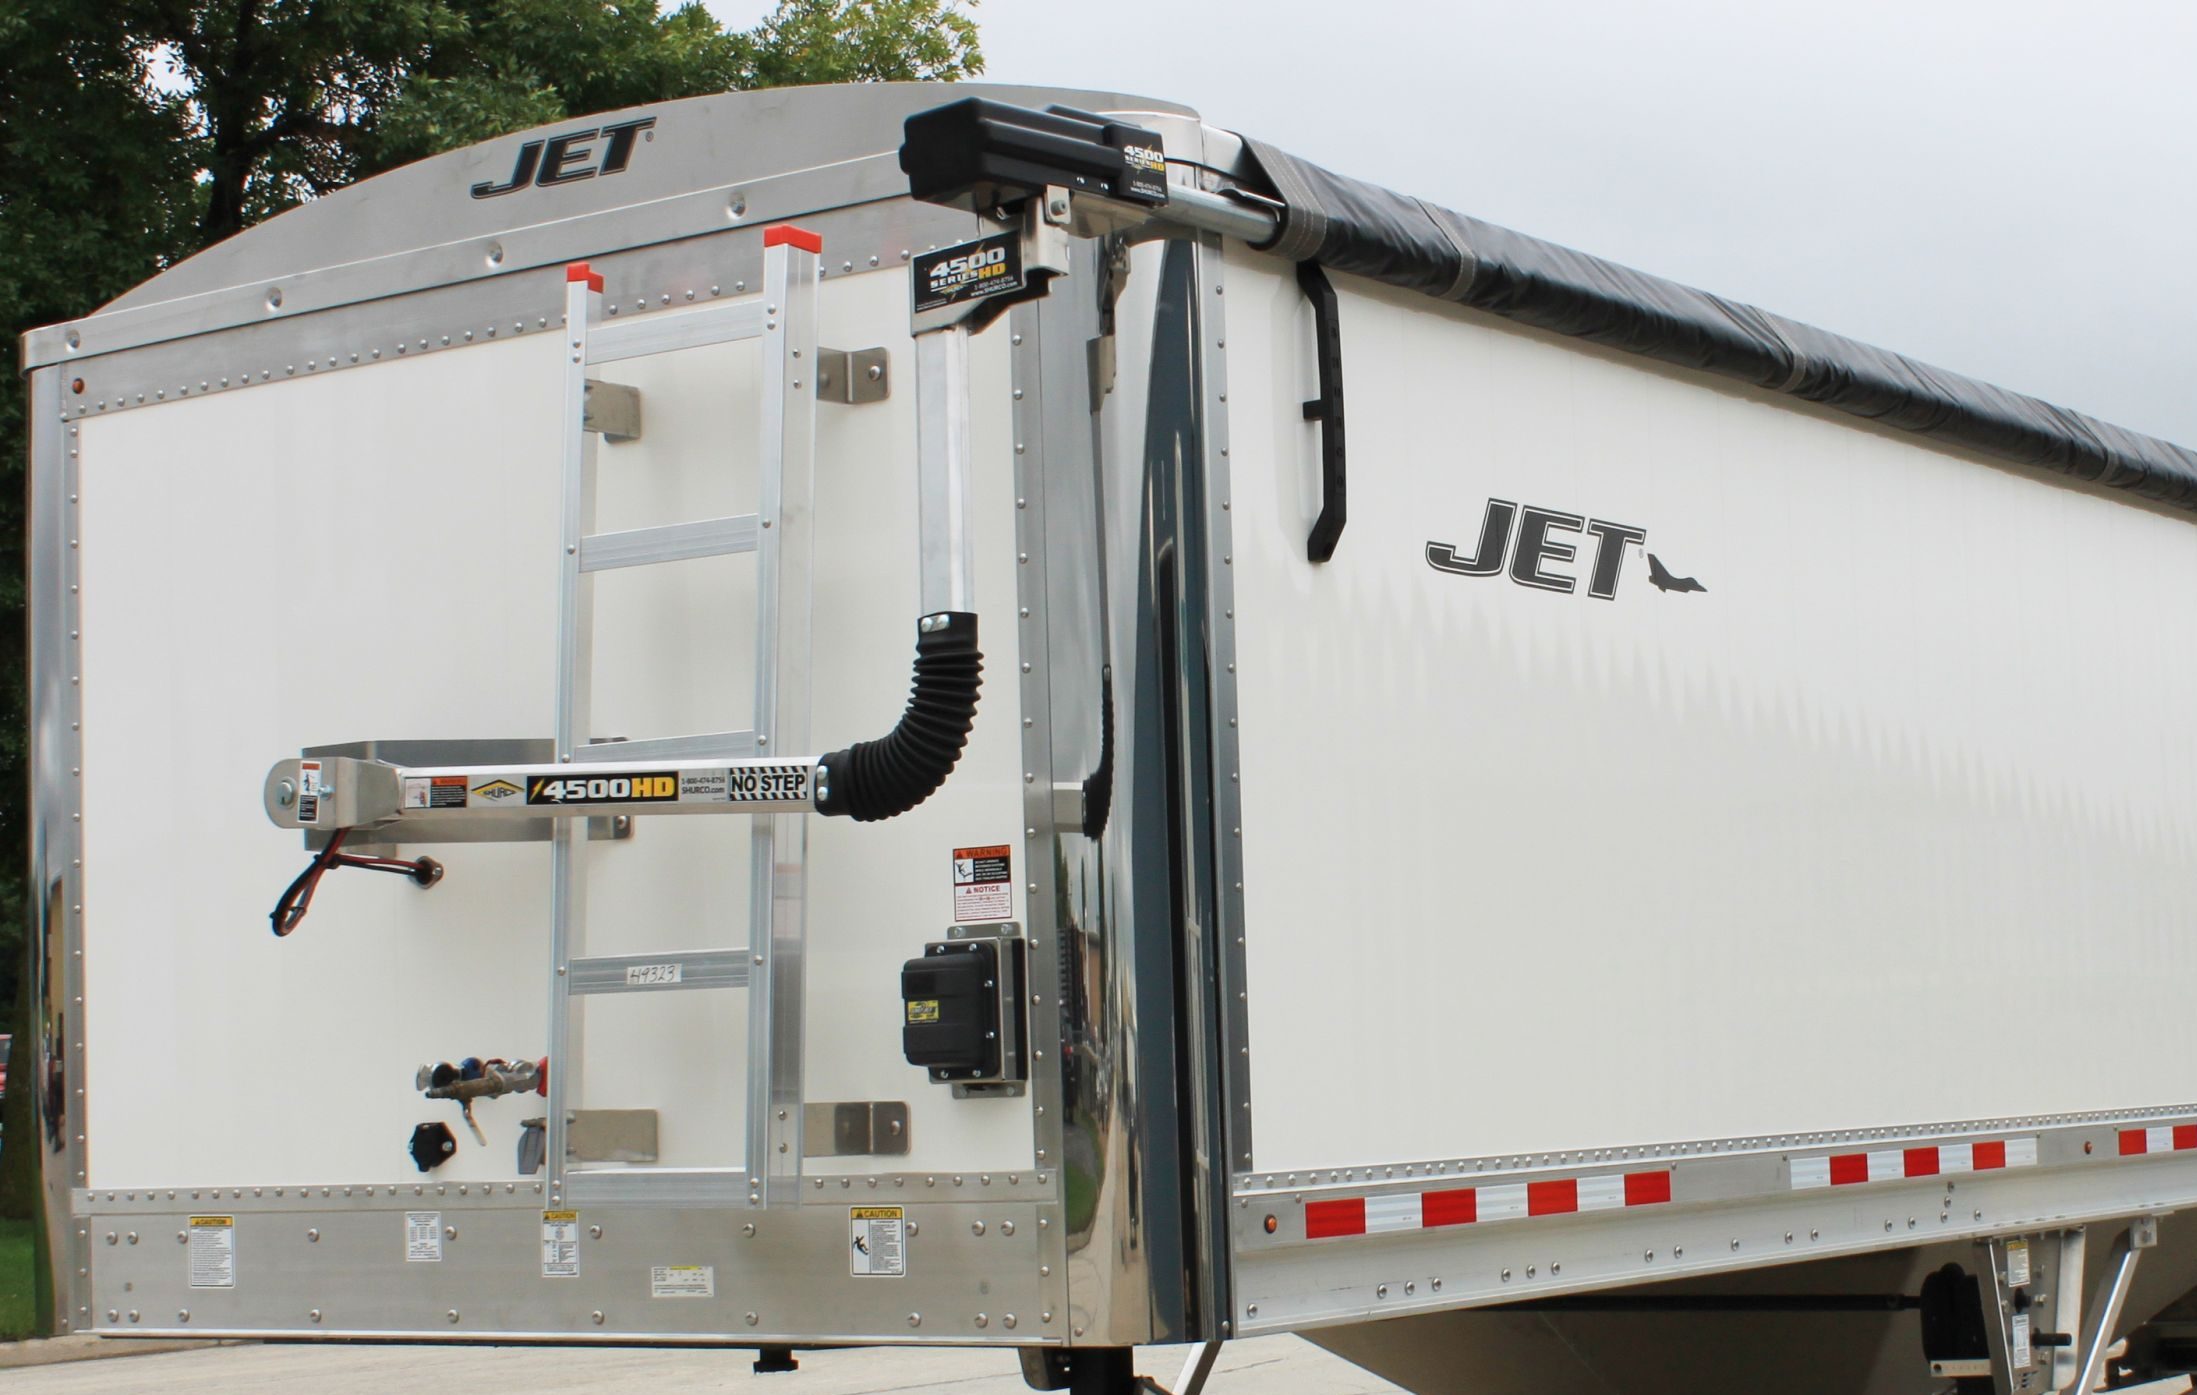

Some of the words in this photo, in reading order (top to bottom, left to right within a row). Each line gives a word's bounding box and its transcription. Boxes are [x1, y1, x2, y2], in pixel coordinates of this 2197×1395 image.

[471, 116, 657, 200] JET
[1124, 145, 1164, 163] 4500
[930, 247, 1005, 278] 4500
[930, 271, 978, 289] SERIES
[978, 263, 1006, 280] HD
[1425, 498, 1647, 601] JET
[731, 775, 757, 793] NO
[761, 774, 805, 793] STEP
[966, 846, 1008, 858] WARNING
[973, 885, 1001, 894] NOTICE
[864, 1209, 898, 1218] CAUTION
